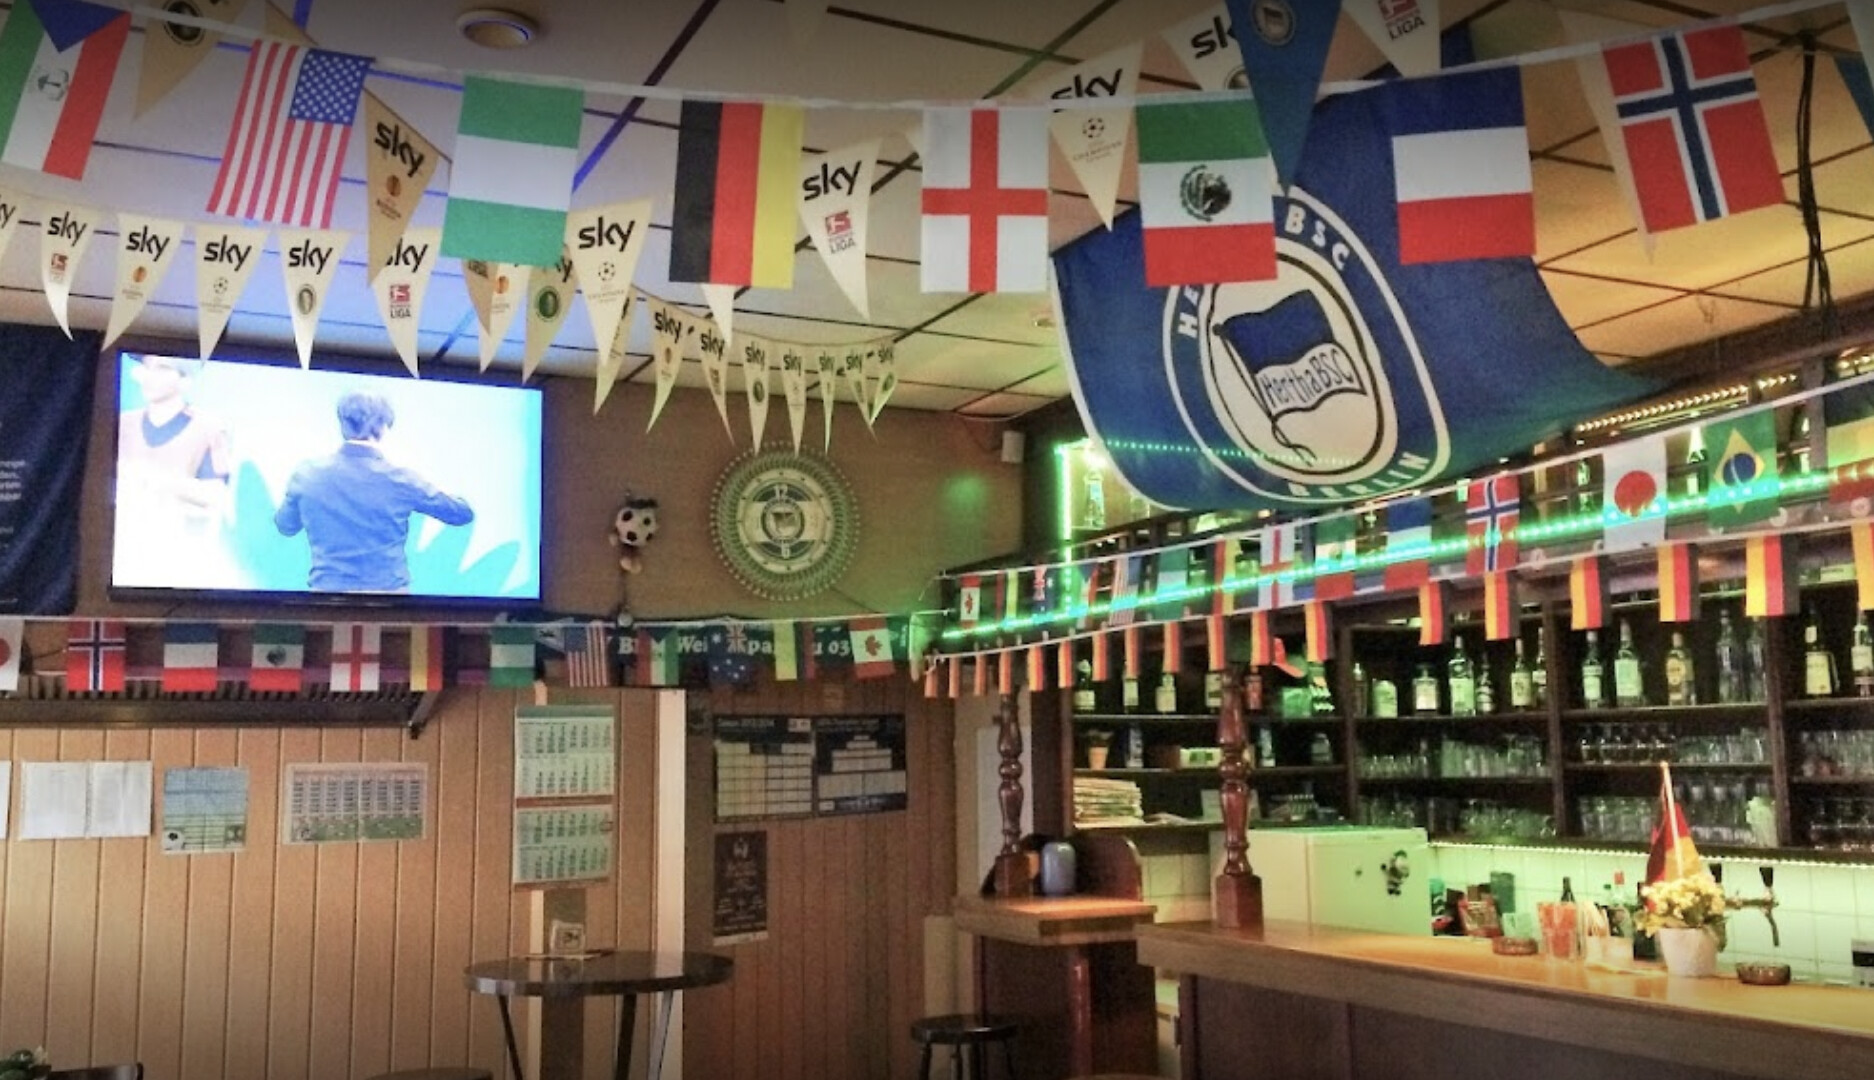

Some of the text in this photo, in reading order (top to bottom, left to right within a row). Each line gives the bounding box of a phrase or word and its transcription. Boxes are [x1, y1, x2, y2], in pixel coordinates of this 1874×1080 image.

[1389, 16, 1426, 41] LIGA
[374, 121, 424, 178] sky
[802, 160, 862, 201] sky
[47, 211, 88, 247] sky
[126, 225, 171, 262] sky
[578, 216, 636, 252] sky
[1284, 204, 1350, 271] BSC
[203, 234, 252, 272] sky
[288, 239, 333, 275] sky
[386, 237, 429, 274] ky
[390, 307, 412, 319] LIGA
[654, 308, 682, 343] sky
[701, 329, 725, 360] sky
[745, 341, 766, 372] sky
[783, 348, 802, 377] sky
[819, 351, 835, 372] sky
[846, 350, 863, 374] sky
[877, 342, 895, 364] sky
[1288, 451, 1431, 498] BERLIN
